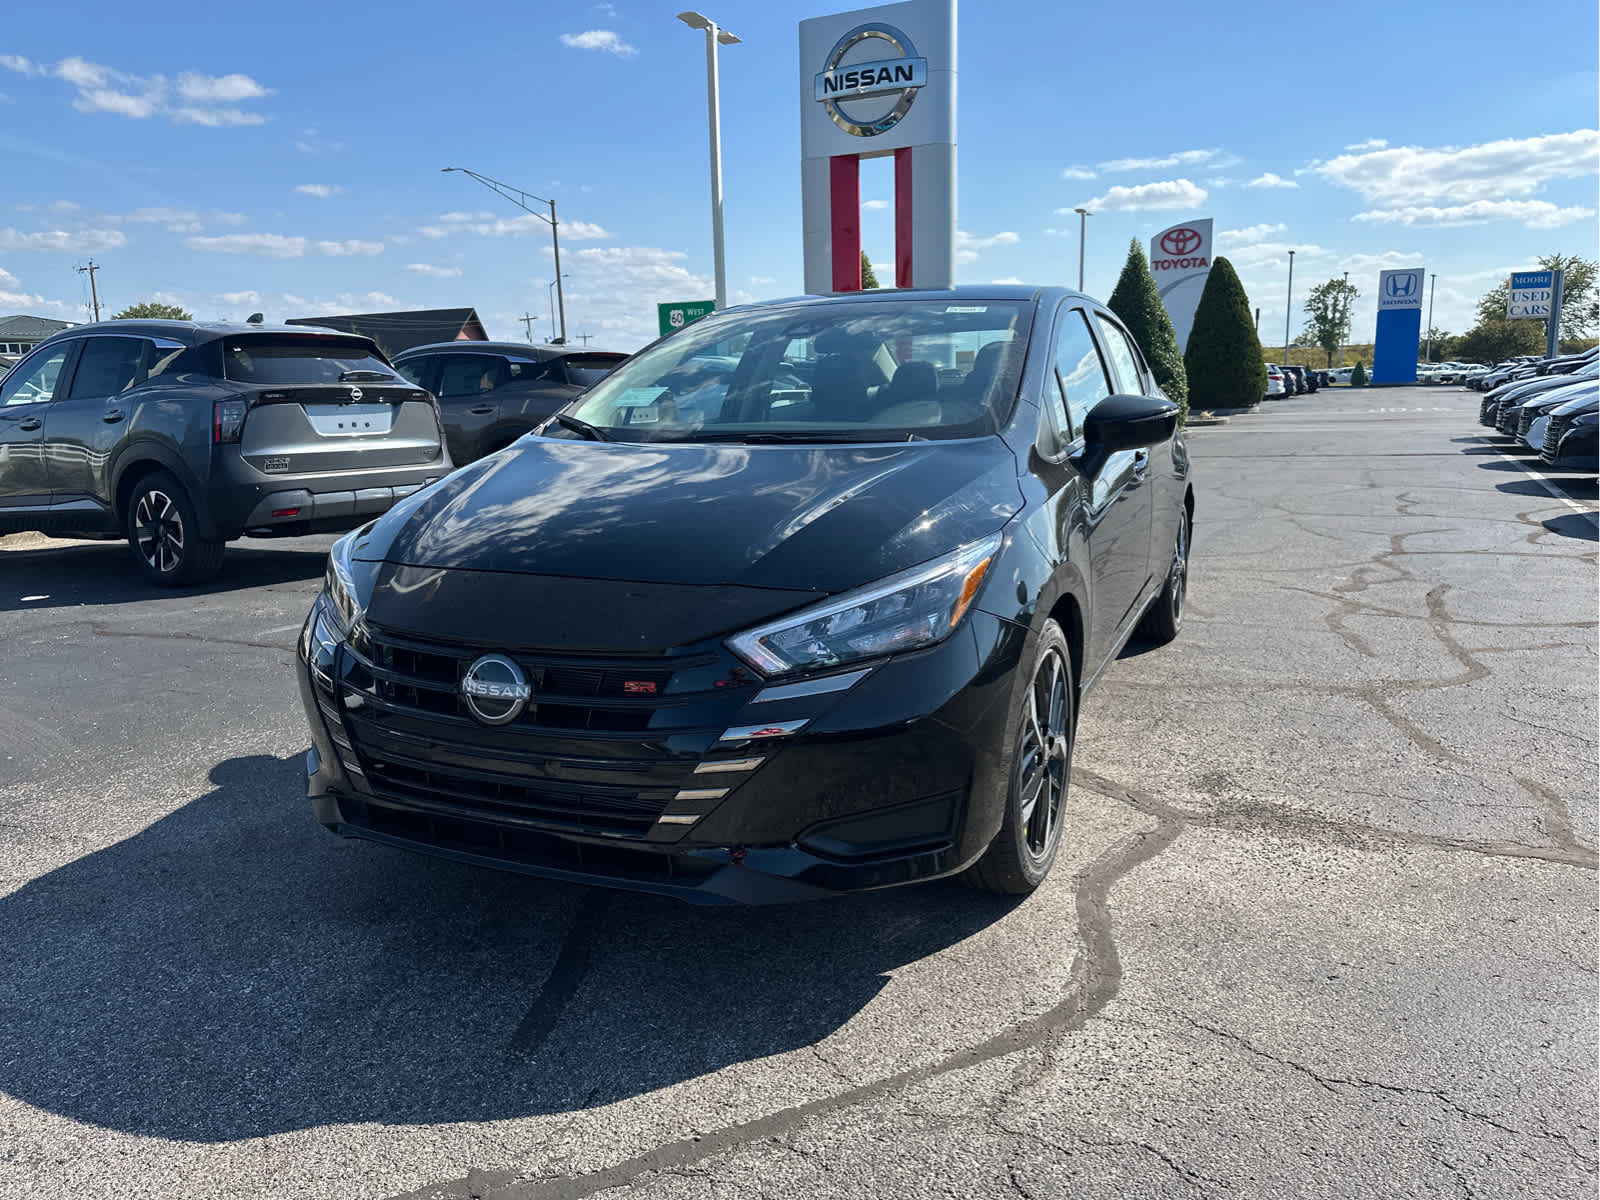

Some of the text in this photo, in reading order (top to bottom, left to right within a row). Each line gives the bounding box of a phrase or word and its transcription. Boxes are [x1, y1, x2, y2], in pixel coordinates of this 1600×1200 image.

[824, 64, 913, 94] NISSAN
[1151, 257, 1208, 271] TOYOTA
[1514, 275, 1550, 285] MOORE
[1511, 291, 1551, 302] USED
[687, 308, 704, 316] WEST
[1510, 305, 1550, 315] CARS
[671, 312, 682, 324] 60
[462, 678, 529, 697] NISSAN
[624, 681, 657, 693] SR
